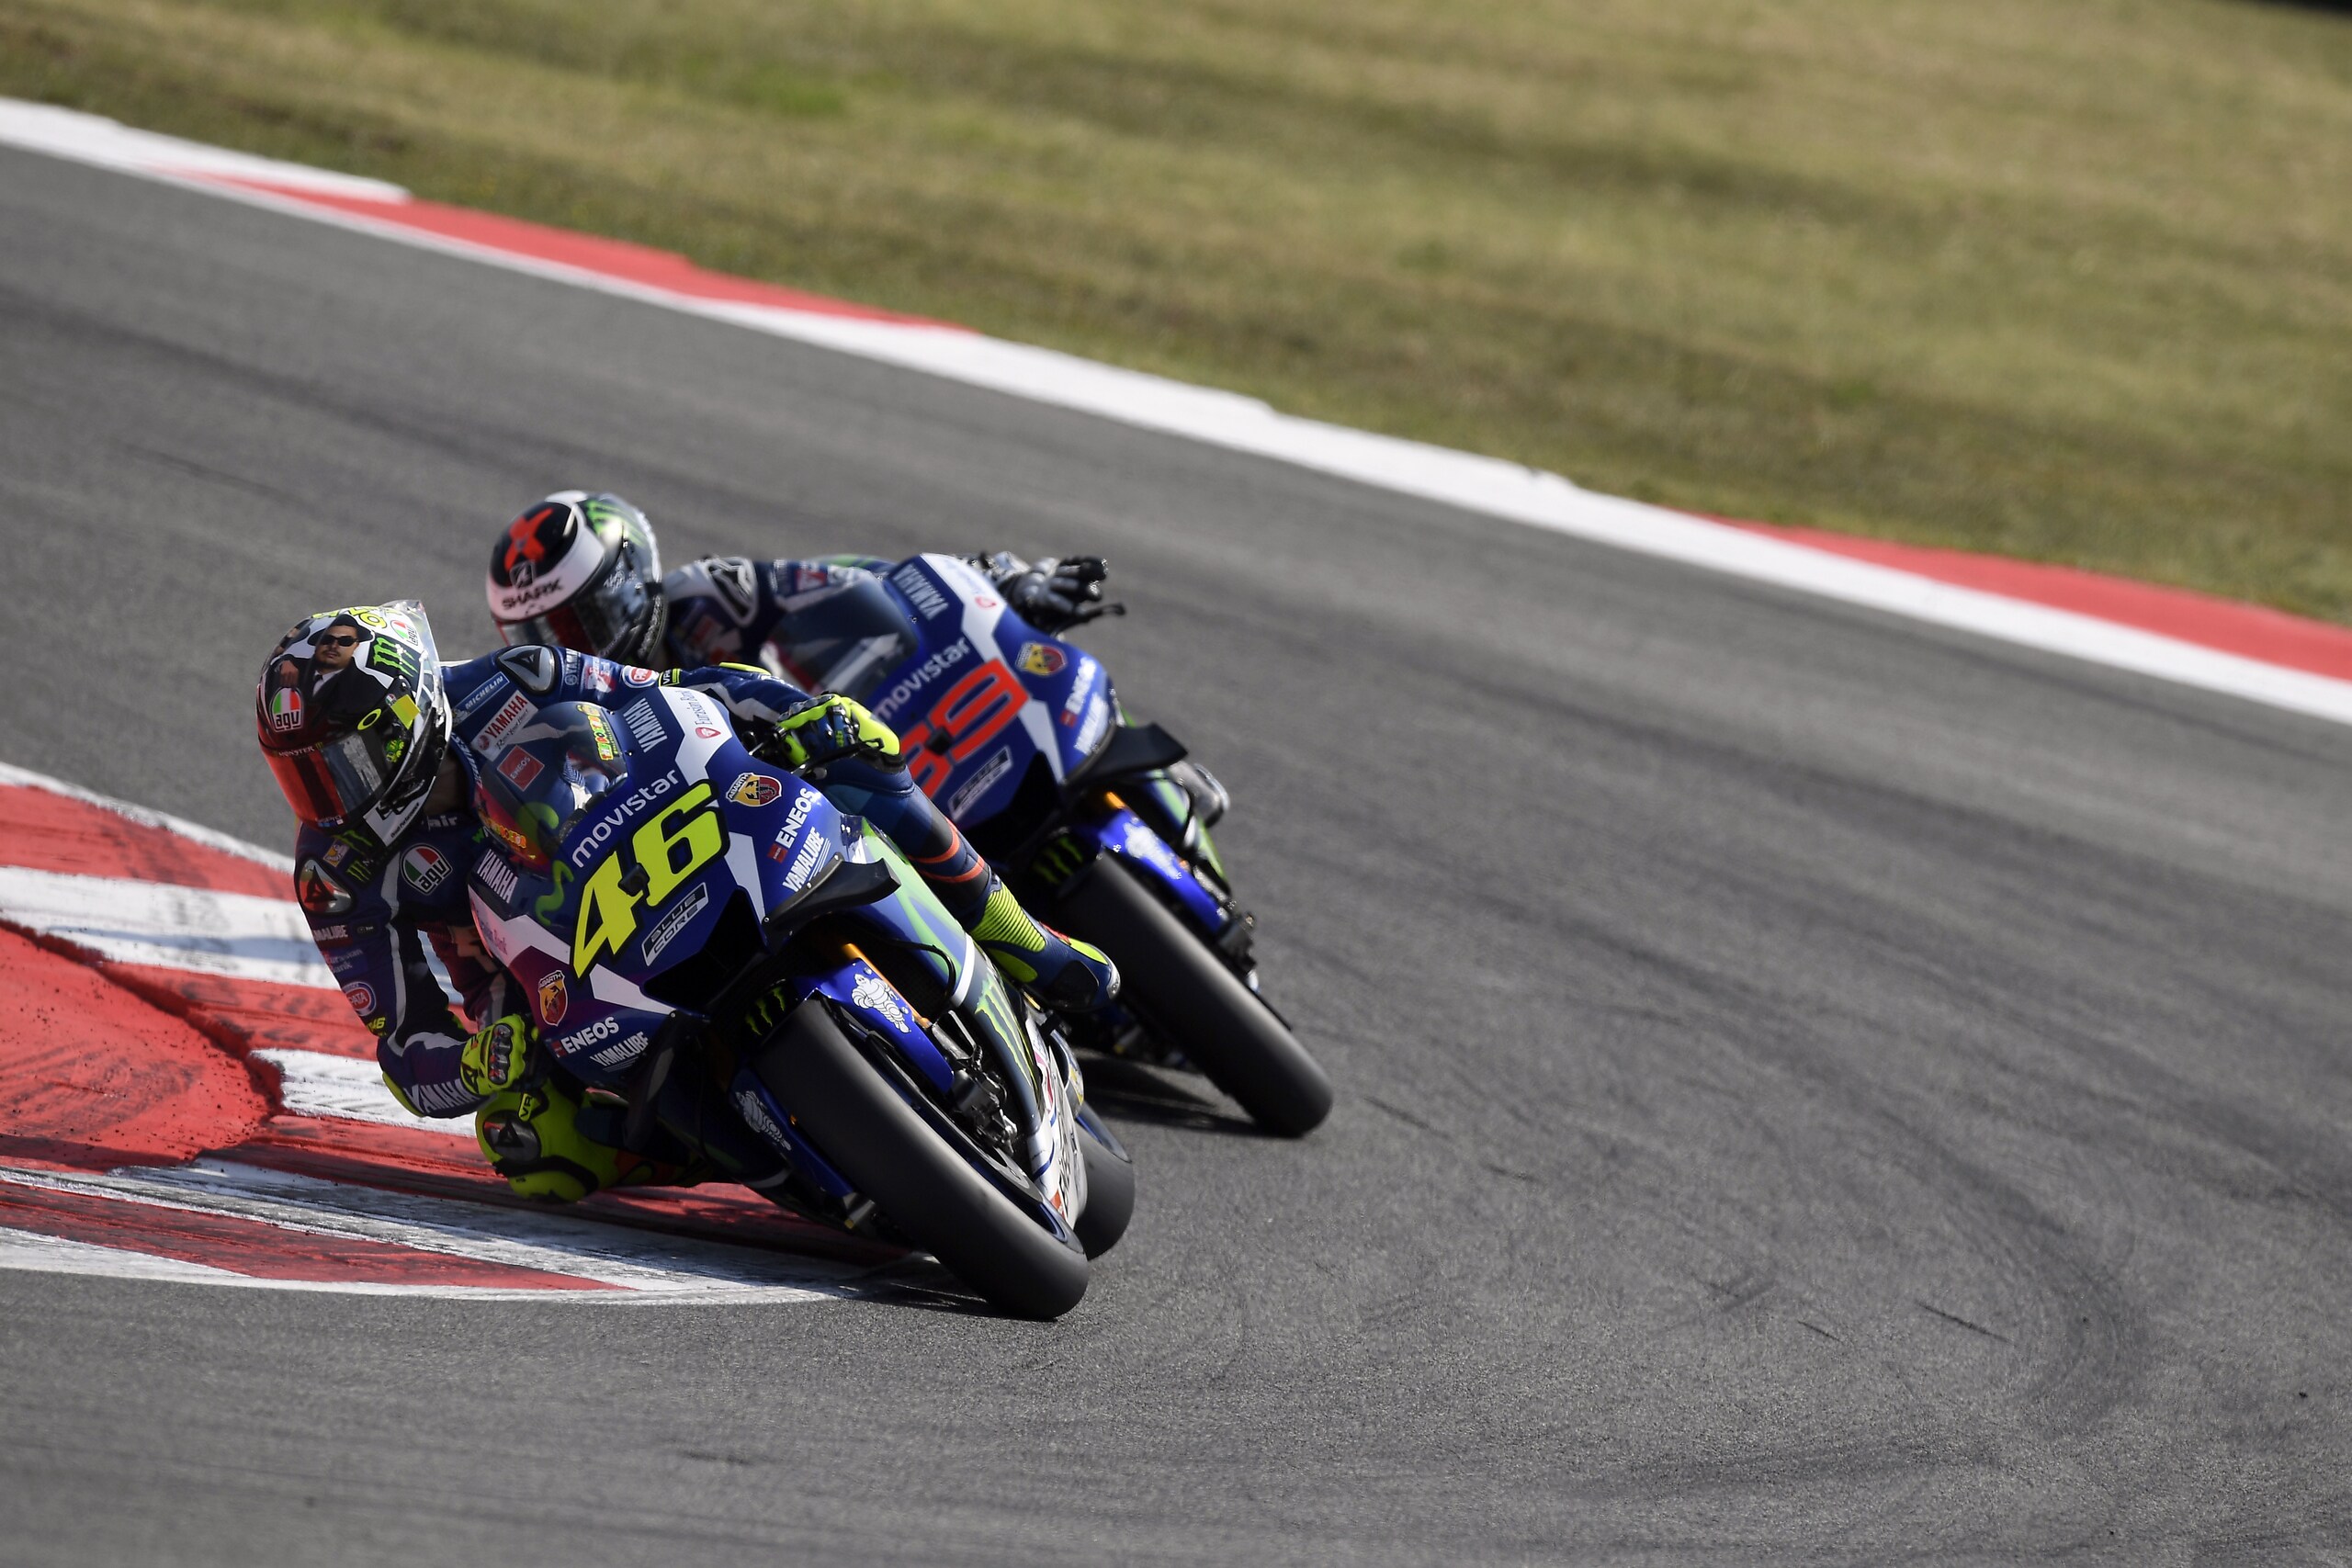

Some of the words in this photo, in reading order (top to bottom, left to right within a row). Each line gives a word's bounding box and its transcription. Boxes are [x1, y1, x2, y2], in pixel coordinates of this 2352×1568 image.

[502, 577, 563, 610] SHARK
[465, 677, 503, 709] MICHELIN
[276, 712, 301, 728] agv
[484, 694, 528, 739] YAMAHA
[623, 697, 668, 753] YAMAHA
[510, 756, 531, 780] ENEOS
[728, 773, 751, 800] ABARTH
[571, 769, 679, 868] movistar
[775, 787, 821, 849] ENEOS
[418, 860, 449, 890] agv
[477, 848, 518, 904] YAMAHA
[571, 781, 724, 980] 46
[782, 826, 825, 893] YAMALUBE
[650, 893, 696, 942] BLUE
[653, 903, 699, 953] CORE
[560, 1016, 619, 1055] ENEOS
[590, 1032, 649, 1066] YAMALUBE
[403, 1078, 481, 1113] YAMAHA
